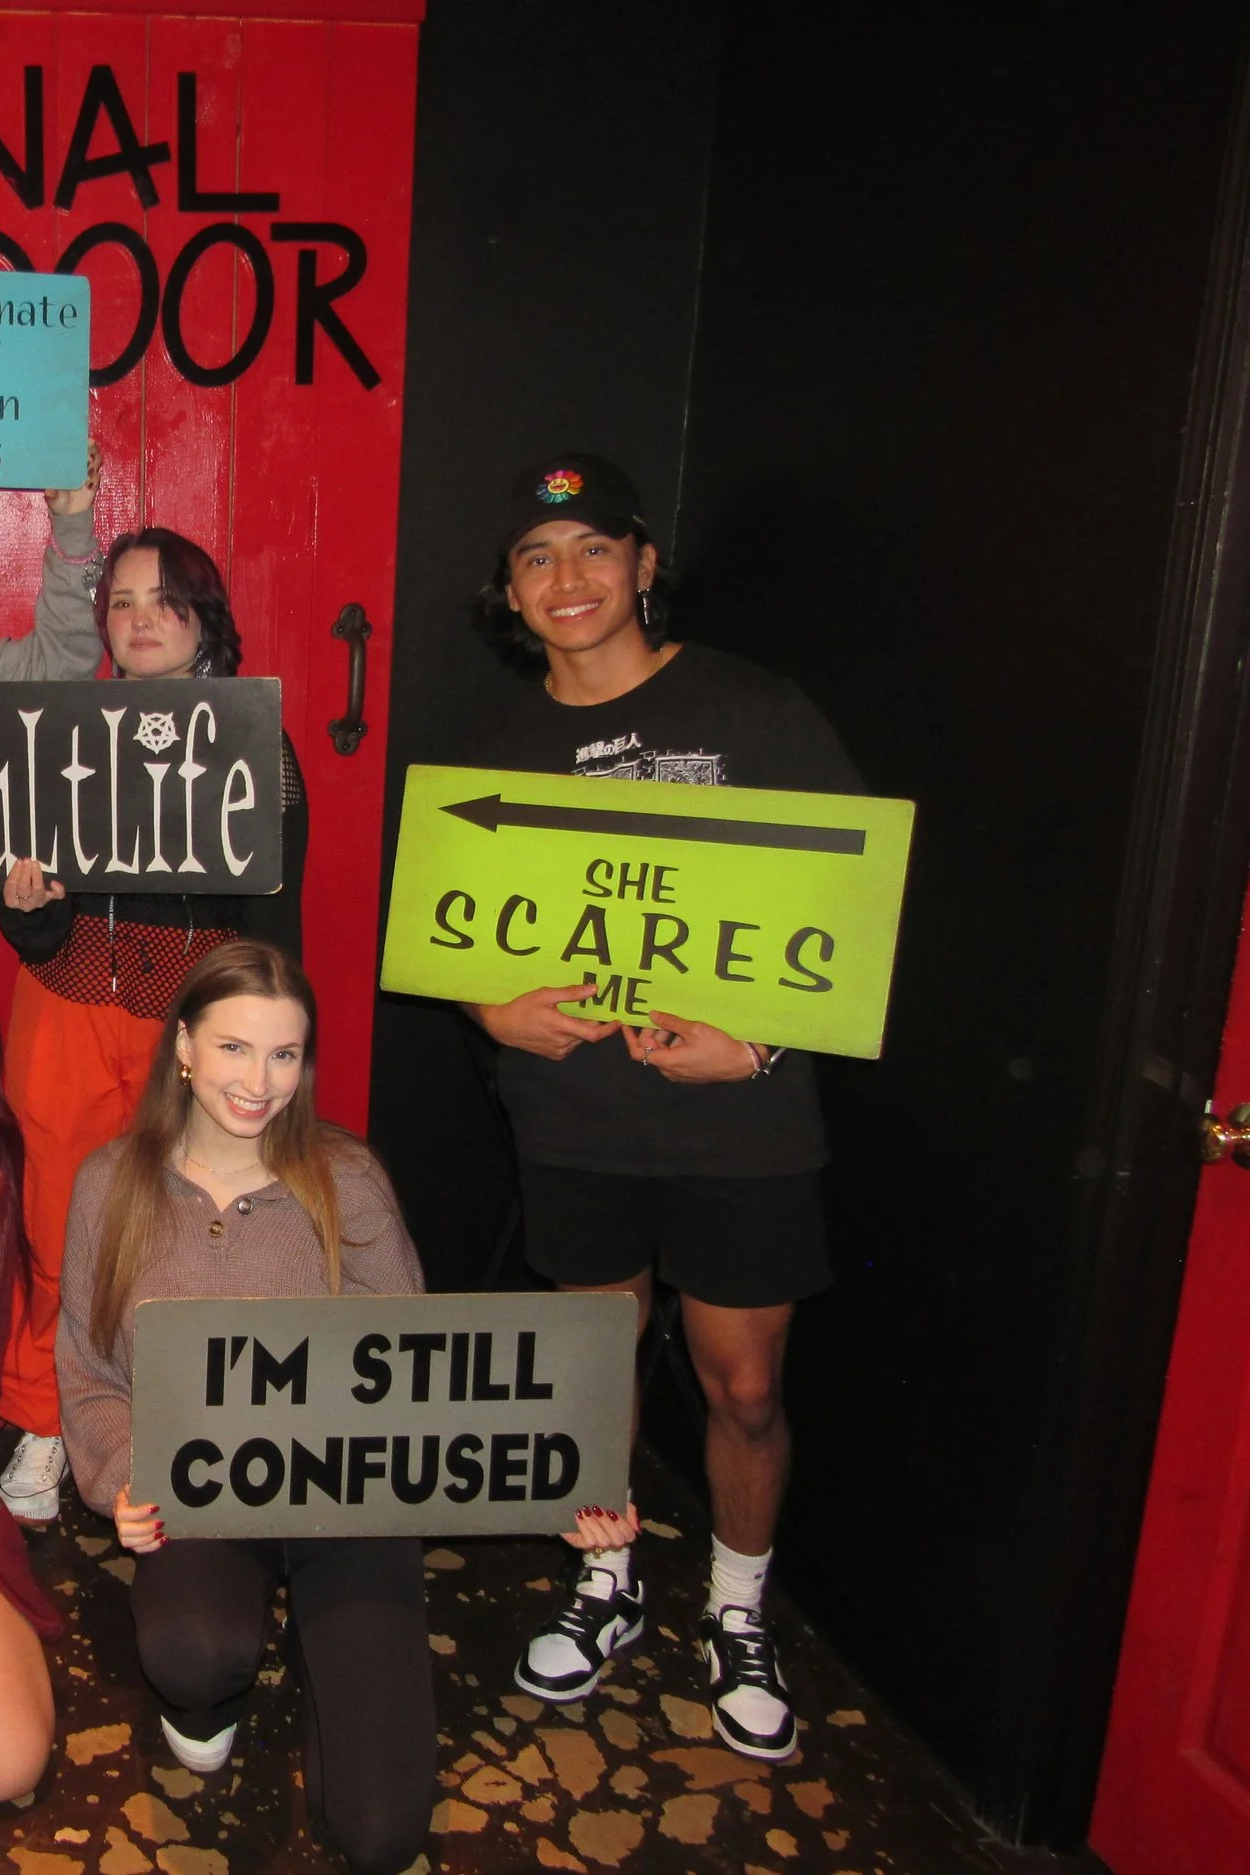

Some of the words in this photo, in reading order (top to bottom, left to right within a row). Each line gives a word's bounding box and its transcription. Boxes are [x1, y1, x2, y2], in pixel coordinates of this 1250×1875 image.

[583, 858, 680, 904] SHE
[429, 890, 835, 993] SCARES
[579, 971, 652, 1016] ME
[205, 1335, 310, 1407] I'M
[350, 1331, 553, 1405] STILL
[170, 1432, 580, 1508] CONFUSED
